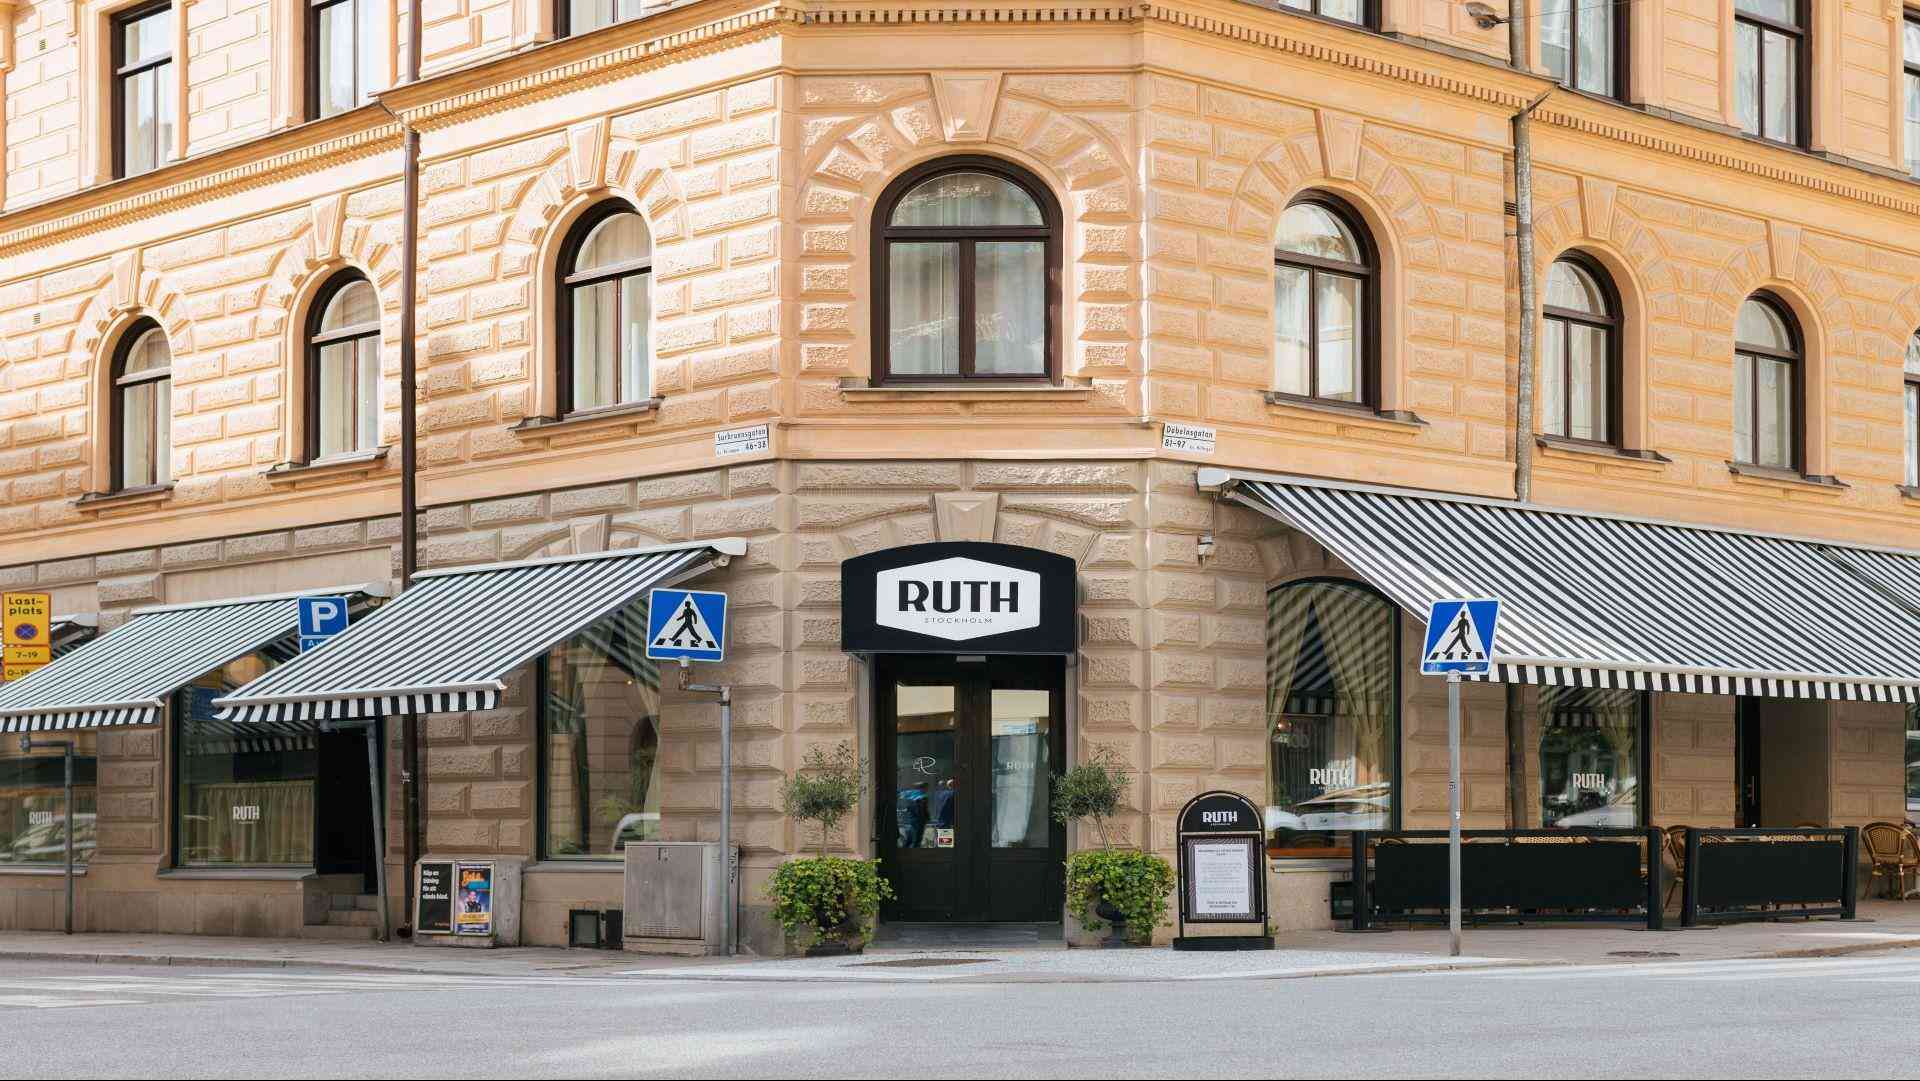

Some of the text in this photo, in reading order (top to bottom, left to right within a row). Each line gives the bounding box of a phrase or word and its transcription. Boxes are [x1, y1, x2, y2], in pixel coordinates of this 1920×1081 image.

[898, 580, 1019, 613] RUTH
[9, 606, 43, 616] plats
[311, 601, 338, 633] P
[1309, 768, 1351, 785] RUTH
[1572, 773, 1605, 789] RUTH
[29, 811, 53, 825] RUTH
[232, 805, 260, 820] RUTH
[1202, 811, 1238, 823] RUTH
